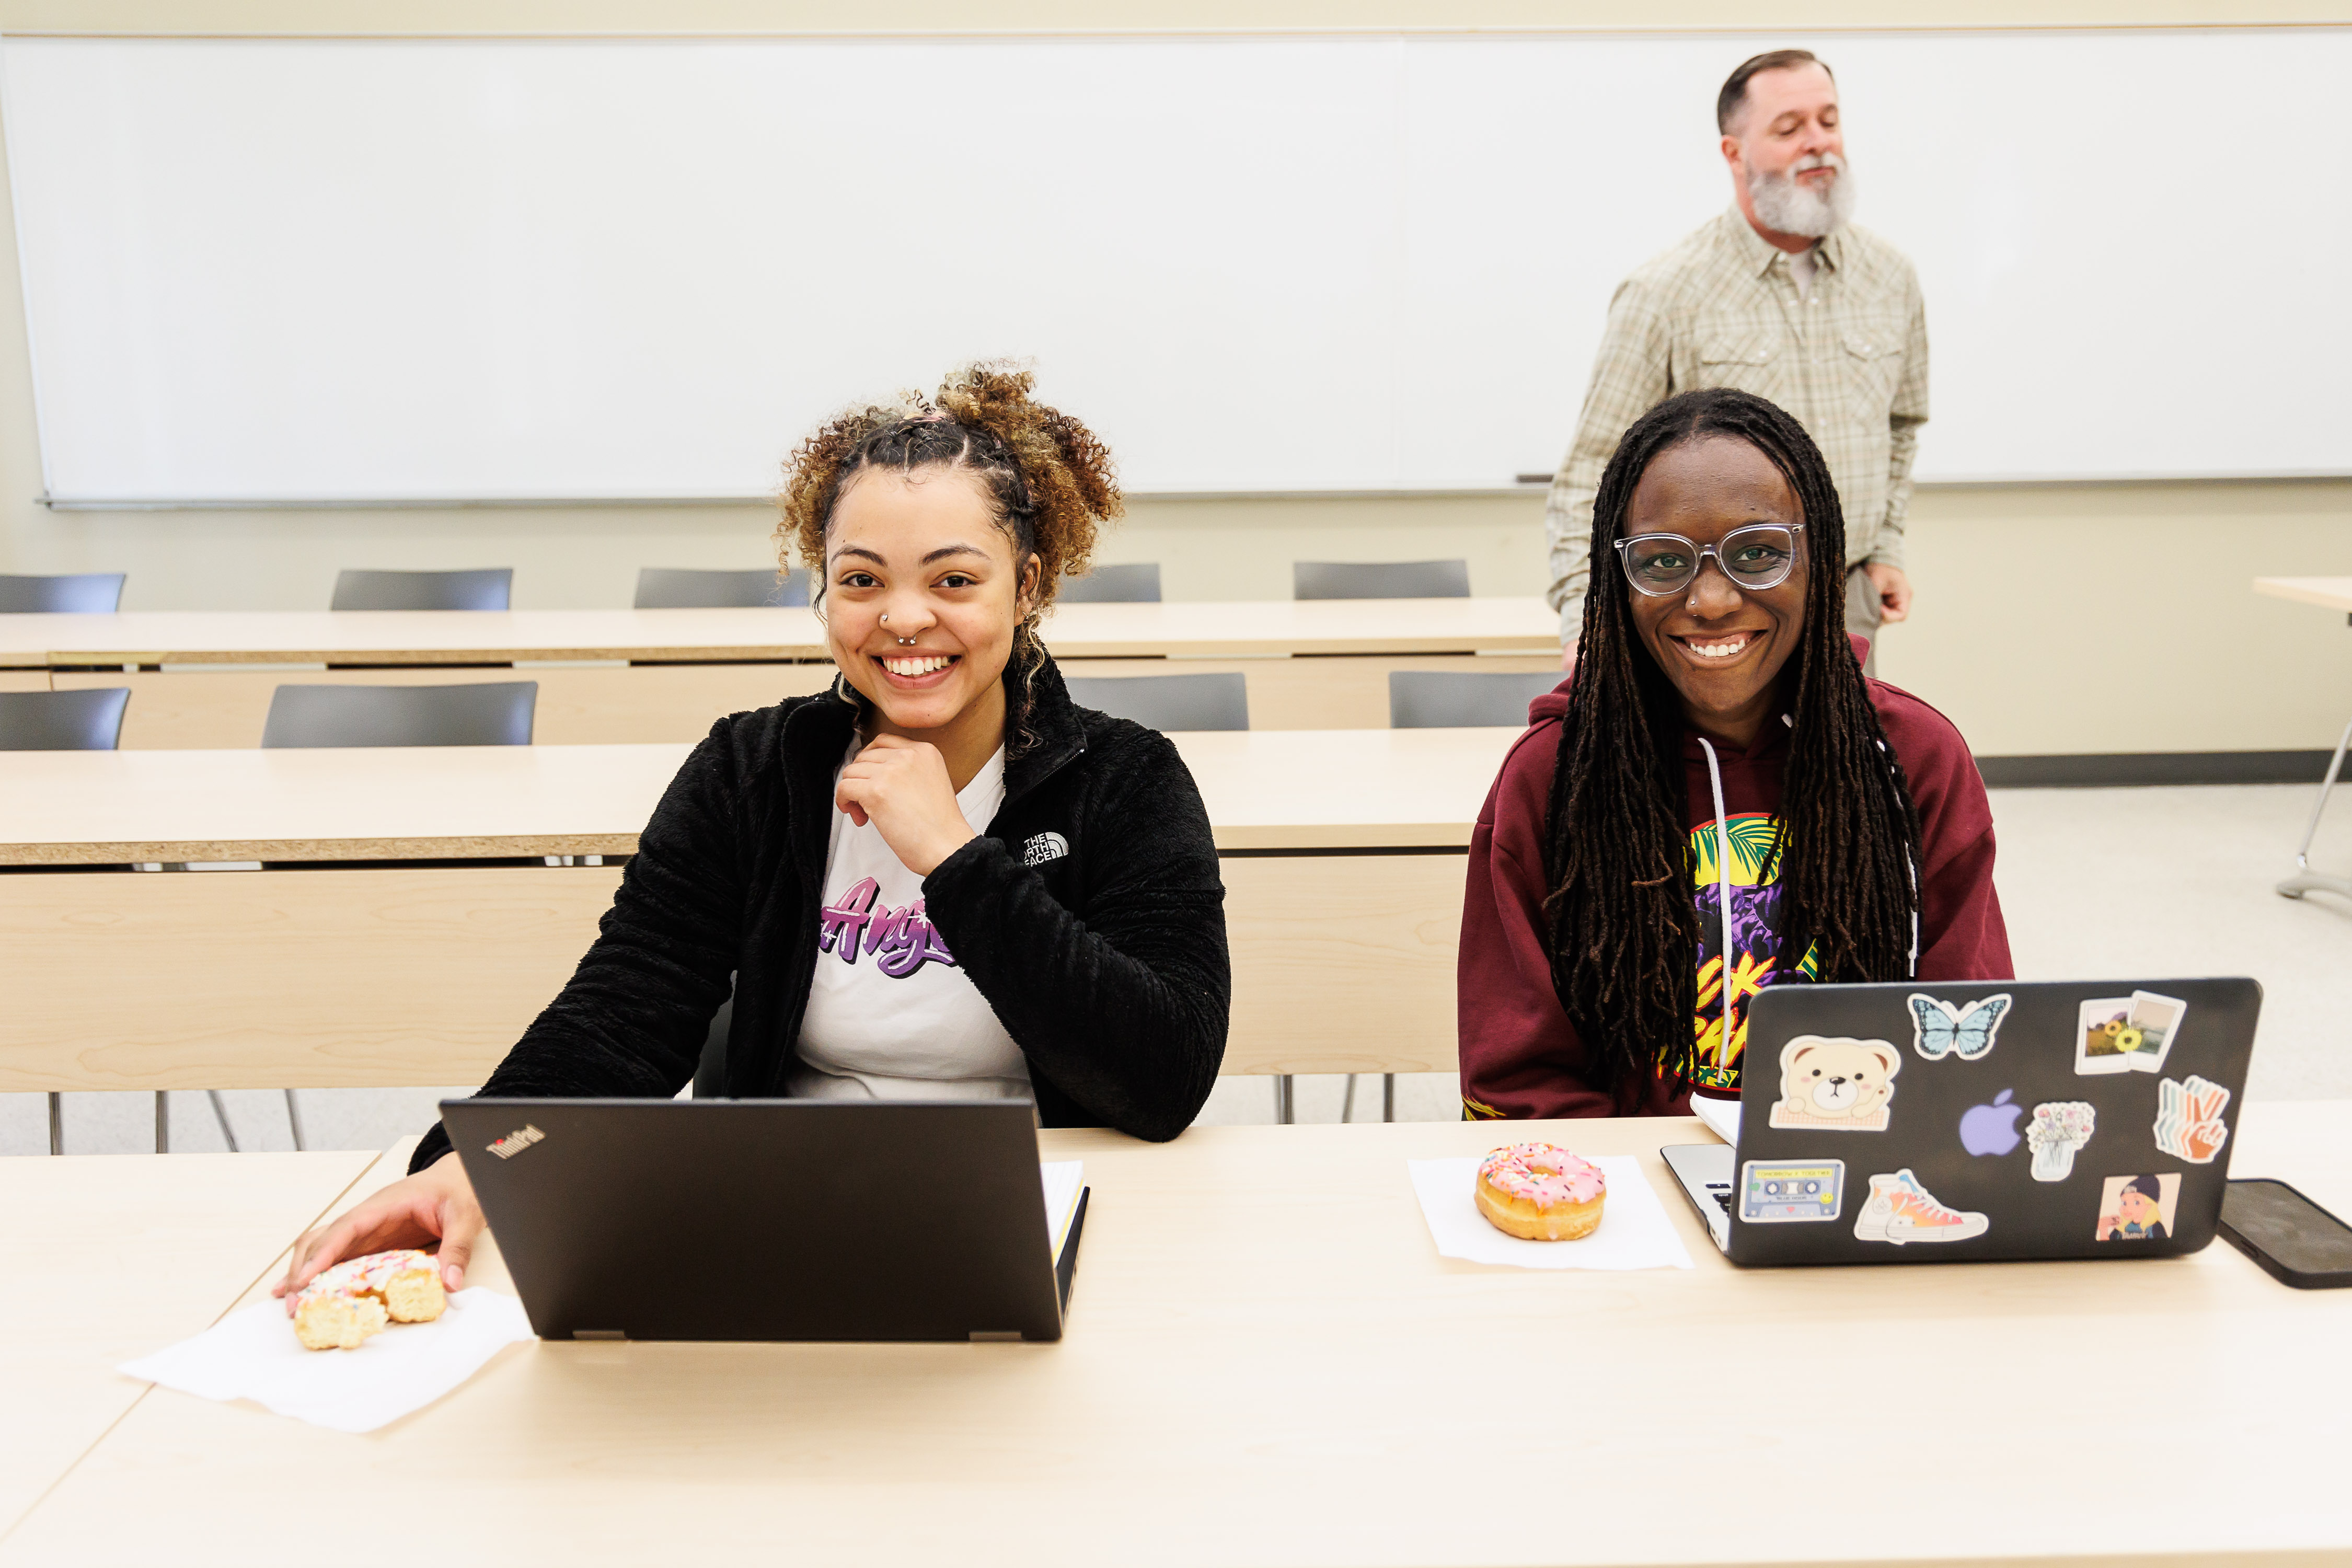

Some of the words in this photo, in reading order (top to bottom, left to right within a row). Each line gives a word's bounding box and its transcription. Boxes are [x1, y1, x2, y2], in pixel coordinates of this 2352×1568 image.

[1024, 833, 1046, 848] THE
[1024, 841, 1049, 860] RTH
[486, 1124, 545, 1160] ThinkPad
